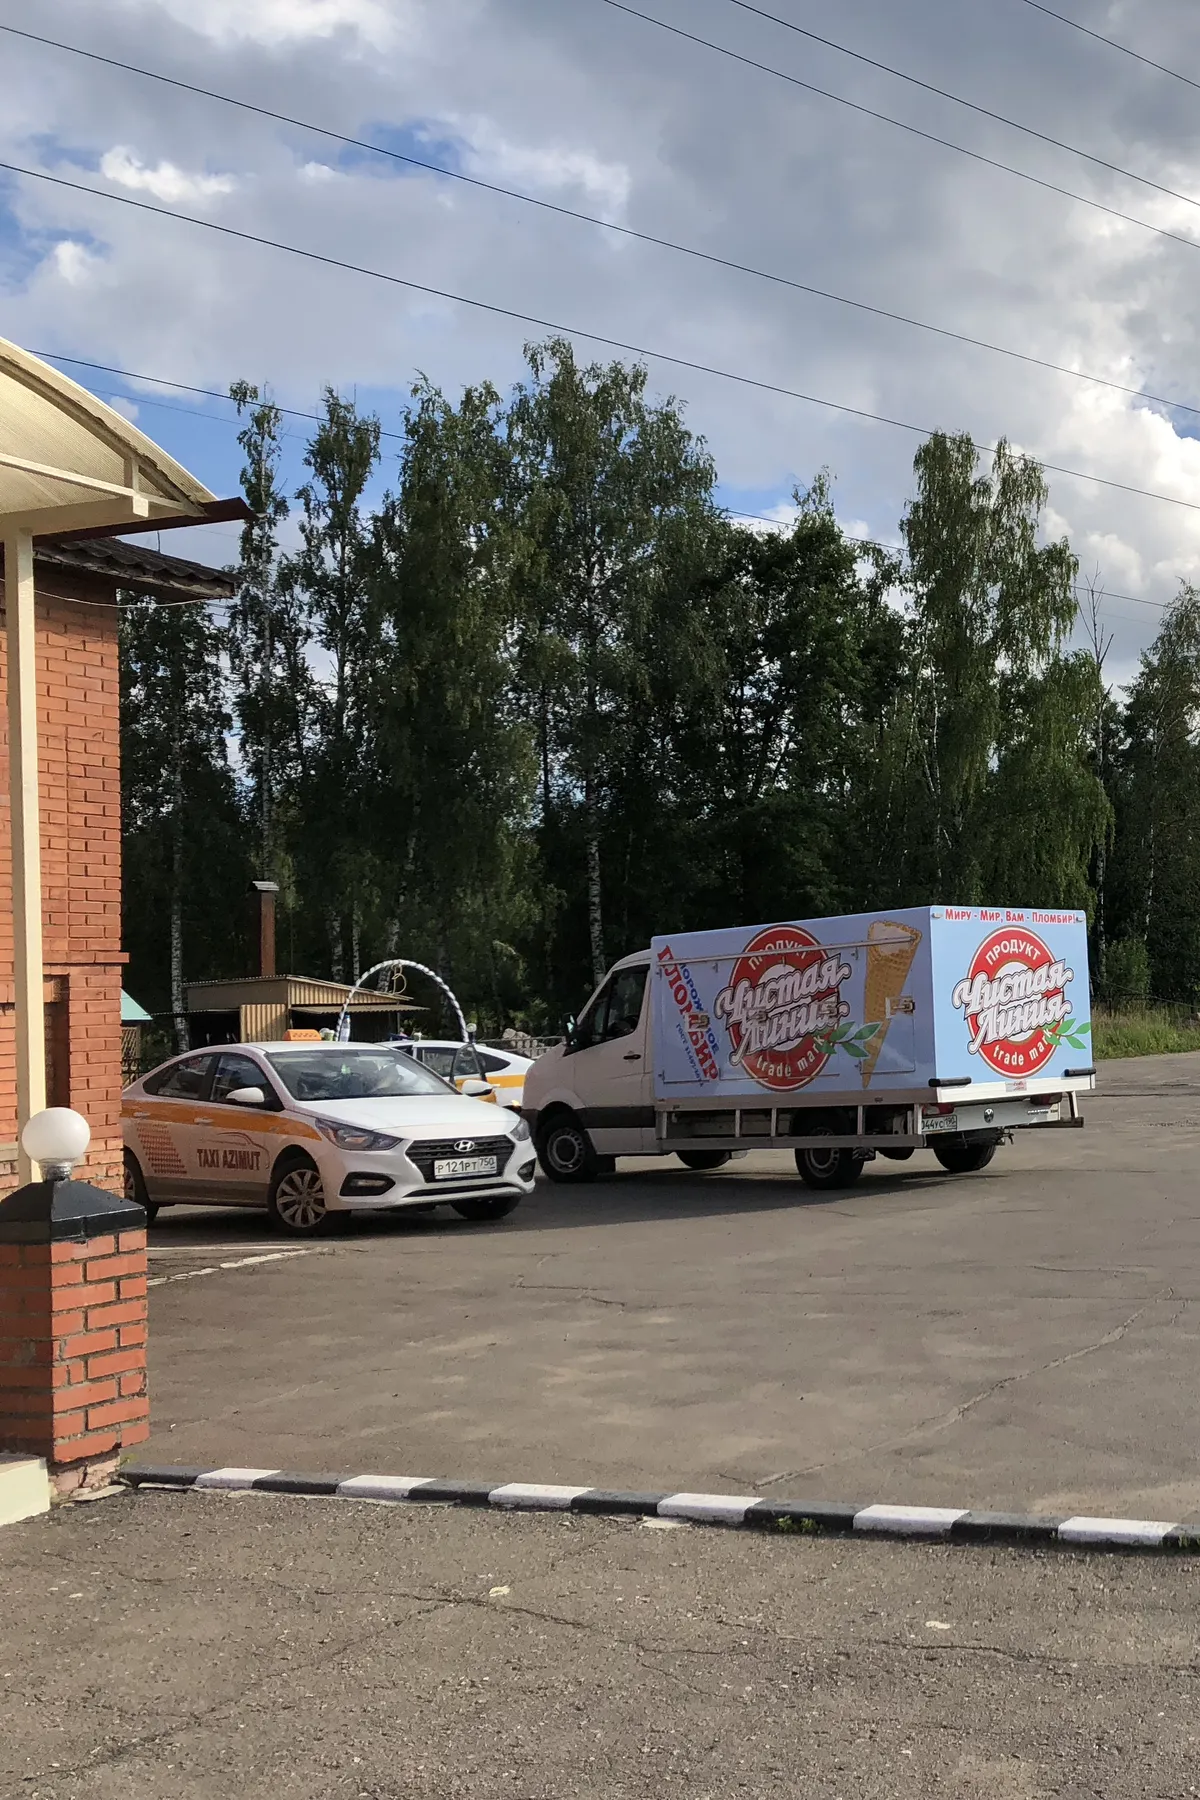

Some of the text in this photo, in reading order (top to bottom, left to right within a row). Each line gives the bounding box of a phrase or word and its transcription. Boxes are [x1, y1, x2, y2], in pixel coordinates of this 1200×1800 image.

[985, 939, 1041, 965] ПРОДУКТ
[714, 953, 852, 1030] Чистая
[952, 959, 1074, 1020] Чистая
[967, 992, 1073, 1055] Линия
[756, 1035, 825, 1077] trade mark
[993, 1028, 1053, 1065] trade mark
[197, 1148, 261, 1170] TAXI AZIMUT
